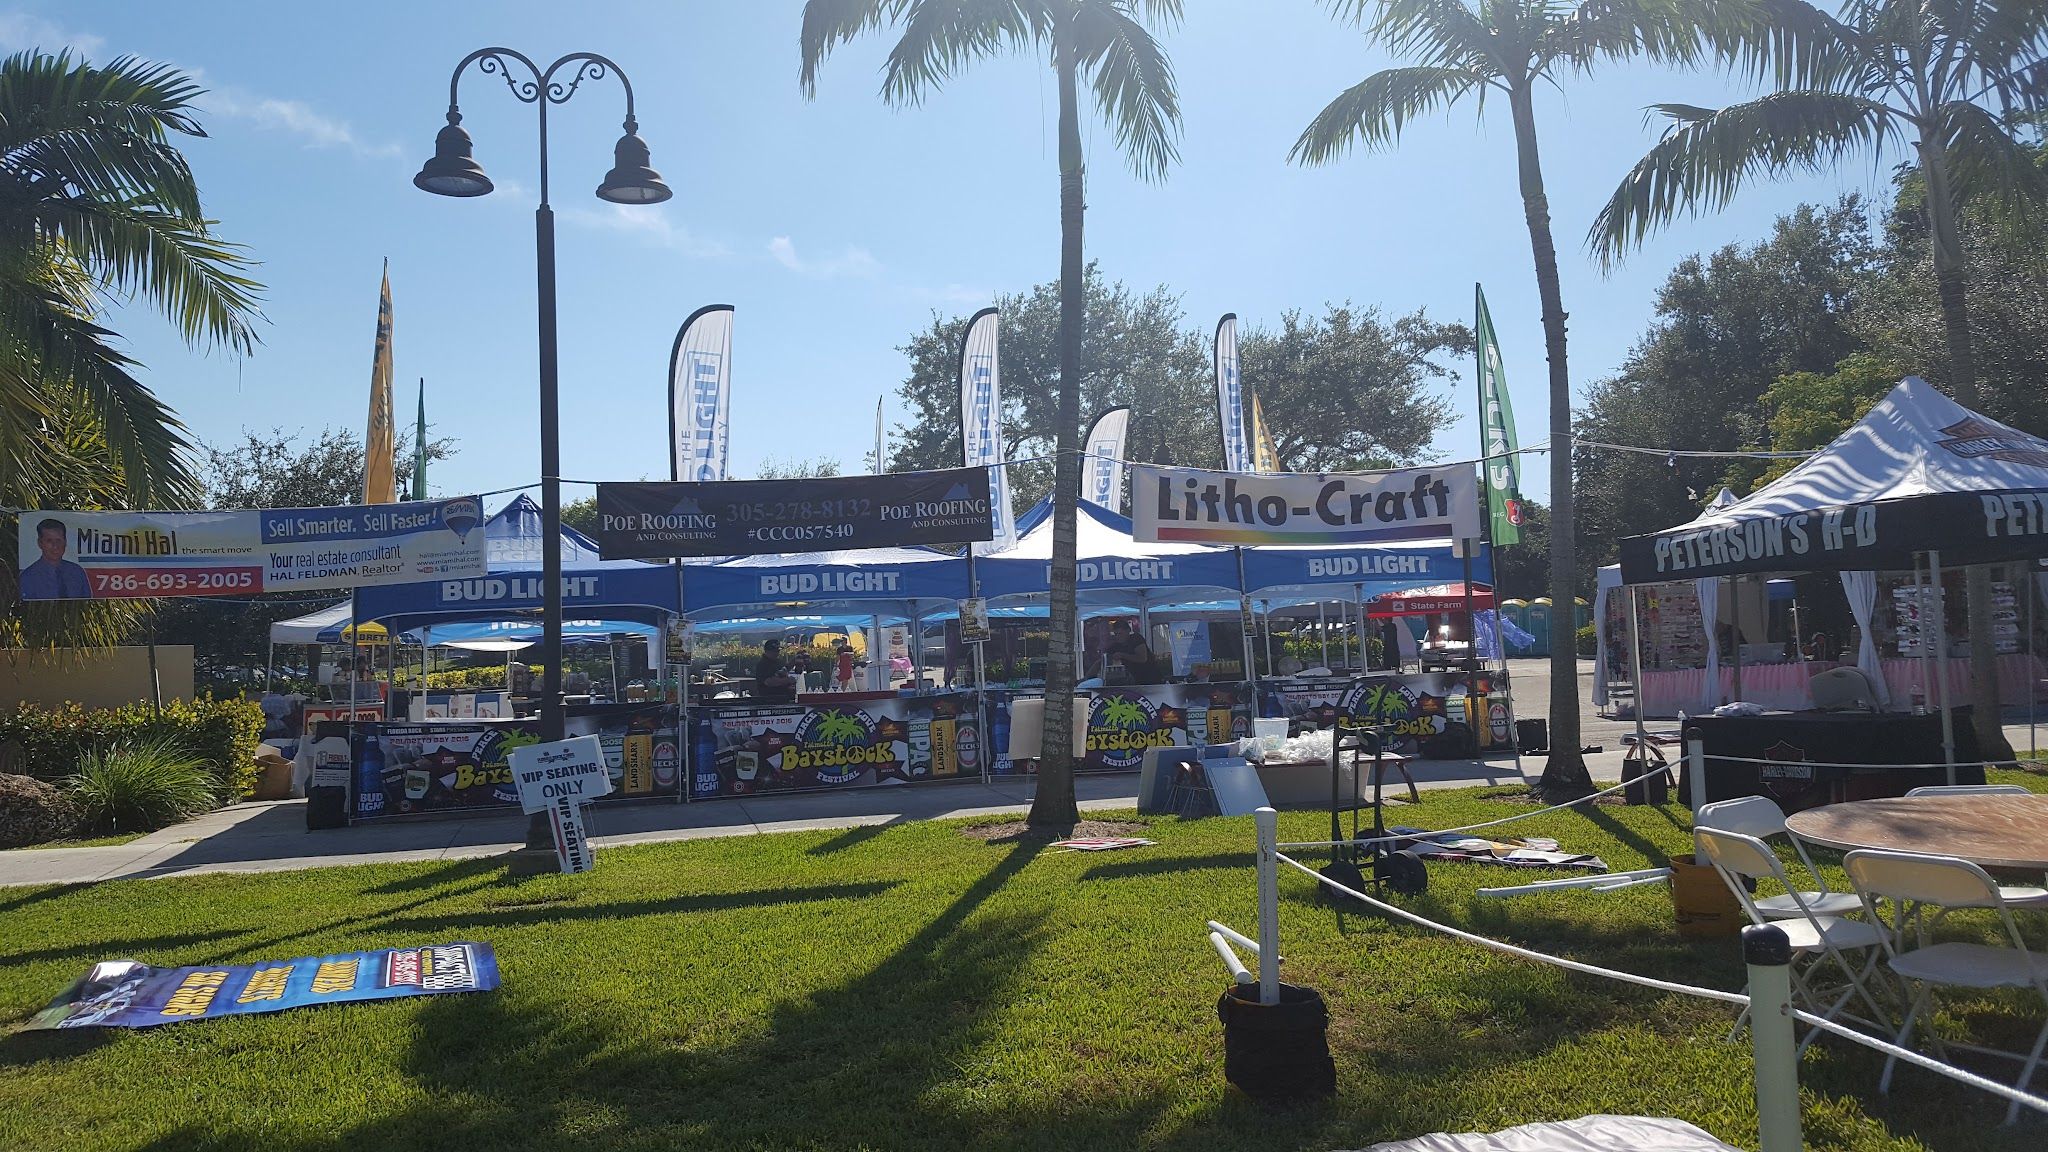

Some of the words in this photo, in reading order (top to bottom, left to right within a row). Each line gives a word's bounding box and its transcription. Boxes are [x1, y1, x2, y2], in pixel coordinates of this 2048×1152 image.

[694, 359, 716, 458] LIGHT
[681, 430, 692, 463] THE
[968, 431, 978, 462] THE
[726, 498, 871, 522] 305-278-8132
[879, 504, 912, 521] POE
[915, 499, 986, 518] ROOFING
[1157, 473, 1451, 527] Litho-Craft
[269, 519, 294, 537] Sell
[297, 517, 357, 536] Smarter.
[363, 514, 387, 532] Sell
[391, 507, 438, 530] Faster!
[602, 514, 637, 531] POE
[641, 512, 716, 530] ROOFING
[748, 523, 854, 542] #CCC057540
[911, 519, 931, 528] AND
[931, 516, 986, 527] CONSULTING
[77, 528, 139, 555] Miami
[146, 531, 178, 555] Hal
[636, 533, 656, 541] AND
[657, 531, 716, 541] CONSULTING
[1654, 513, 1810, 573] PETERSON'S
[1821, 504, 1877, 551] H-D
[182, 547, 197, 555] the
[198, 546, 225, 555] smart
[227, 546, 252, 554] move
[270, 552, 294, 569] Your
[295, 551, 315, 567] real
[317, 550, 348, 566] estate
[350, 544, 402, 563] consultant
[270, 572, 295, 581] HAL
[1101, 561, 1173, 580] LIGHT
[1309, 556, 1358, 577] BUD
[1362, 555, 1428, 574] LIGHT
[96, 572, 252, 591] 786-693-2005
[442, 579, 507, 601] BUD
[760, 574, 818, 595] BUD
[822, 571, 898, 593] LIGHT
[1410, 602, 1435, 610] State
[1437, 601, 1462, 609] Farm
[1137, 696, 1158, 719] LOVE
[1347, 687, 1367, 715] PEACE
[1399, 685, 1418, 707] LOVE
[795, 712, 818, 742] PEACE
[855, 710, 877, 733] LOVE
[472, 730, 499, 761] PEACE
[936, 726, 945, 770] LANDSHARK
[630, 742, 639, 788] LANDSHARK
[1102, 754, 1142, 767] FESTIVAL
[454, 764, 513, 790] Bays
[521, 770, 544, 783] VIP
[545, 762, 598, 780] SEATING
[696, 774, 717, 783] BUD
[816, 770, 860, 783] FESTIVAL
[360, 792, 384, 803] BUD
[542, 780, 584, 798] ONLY
[563, 821, 584, 873] SEATING
[160, 987, 219, 1016] SIGNS
